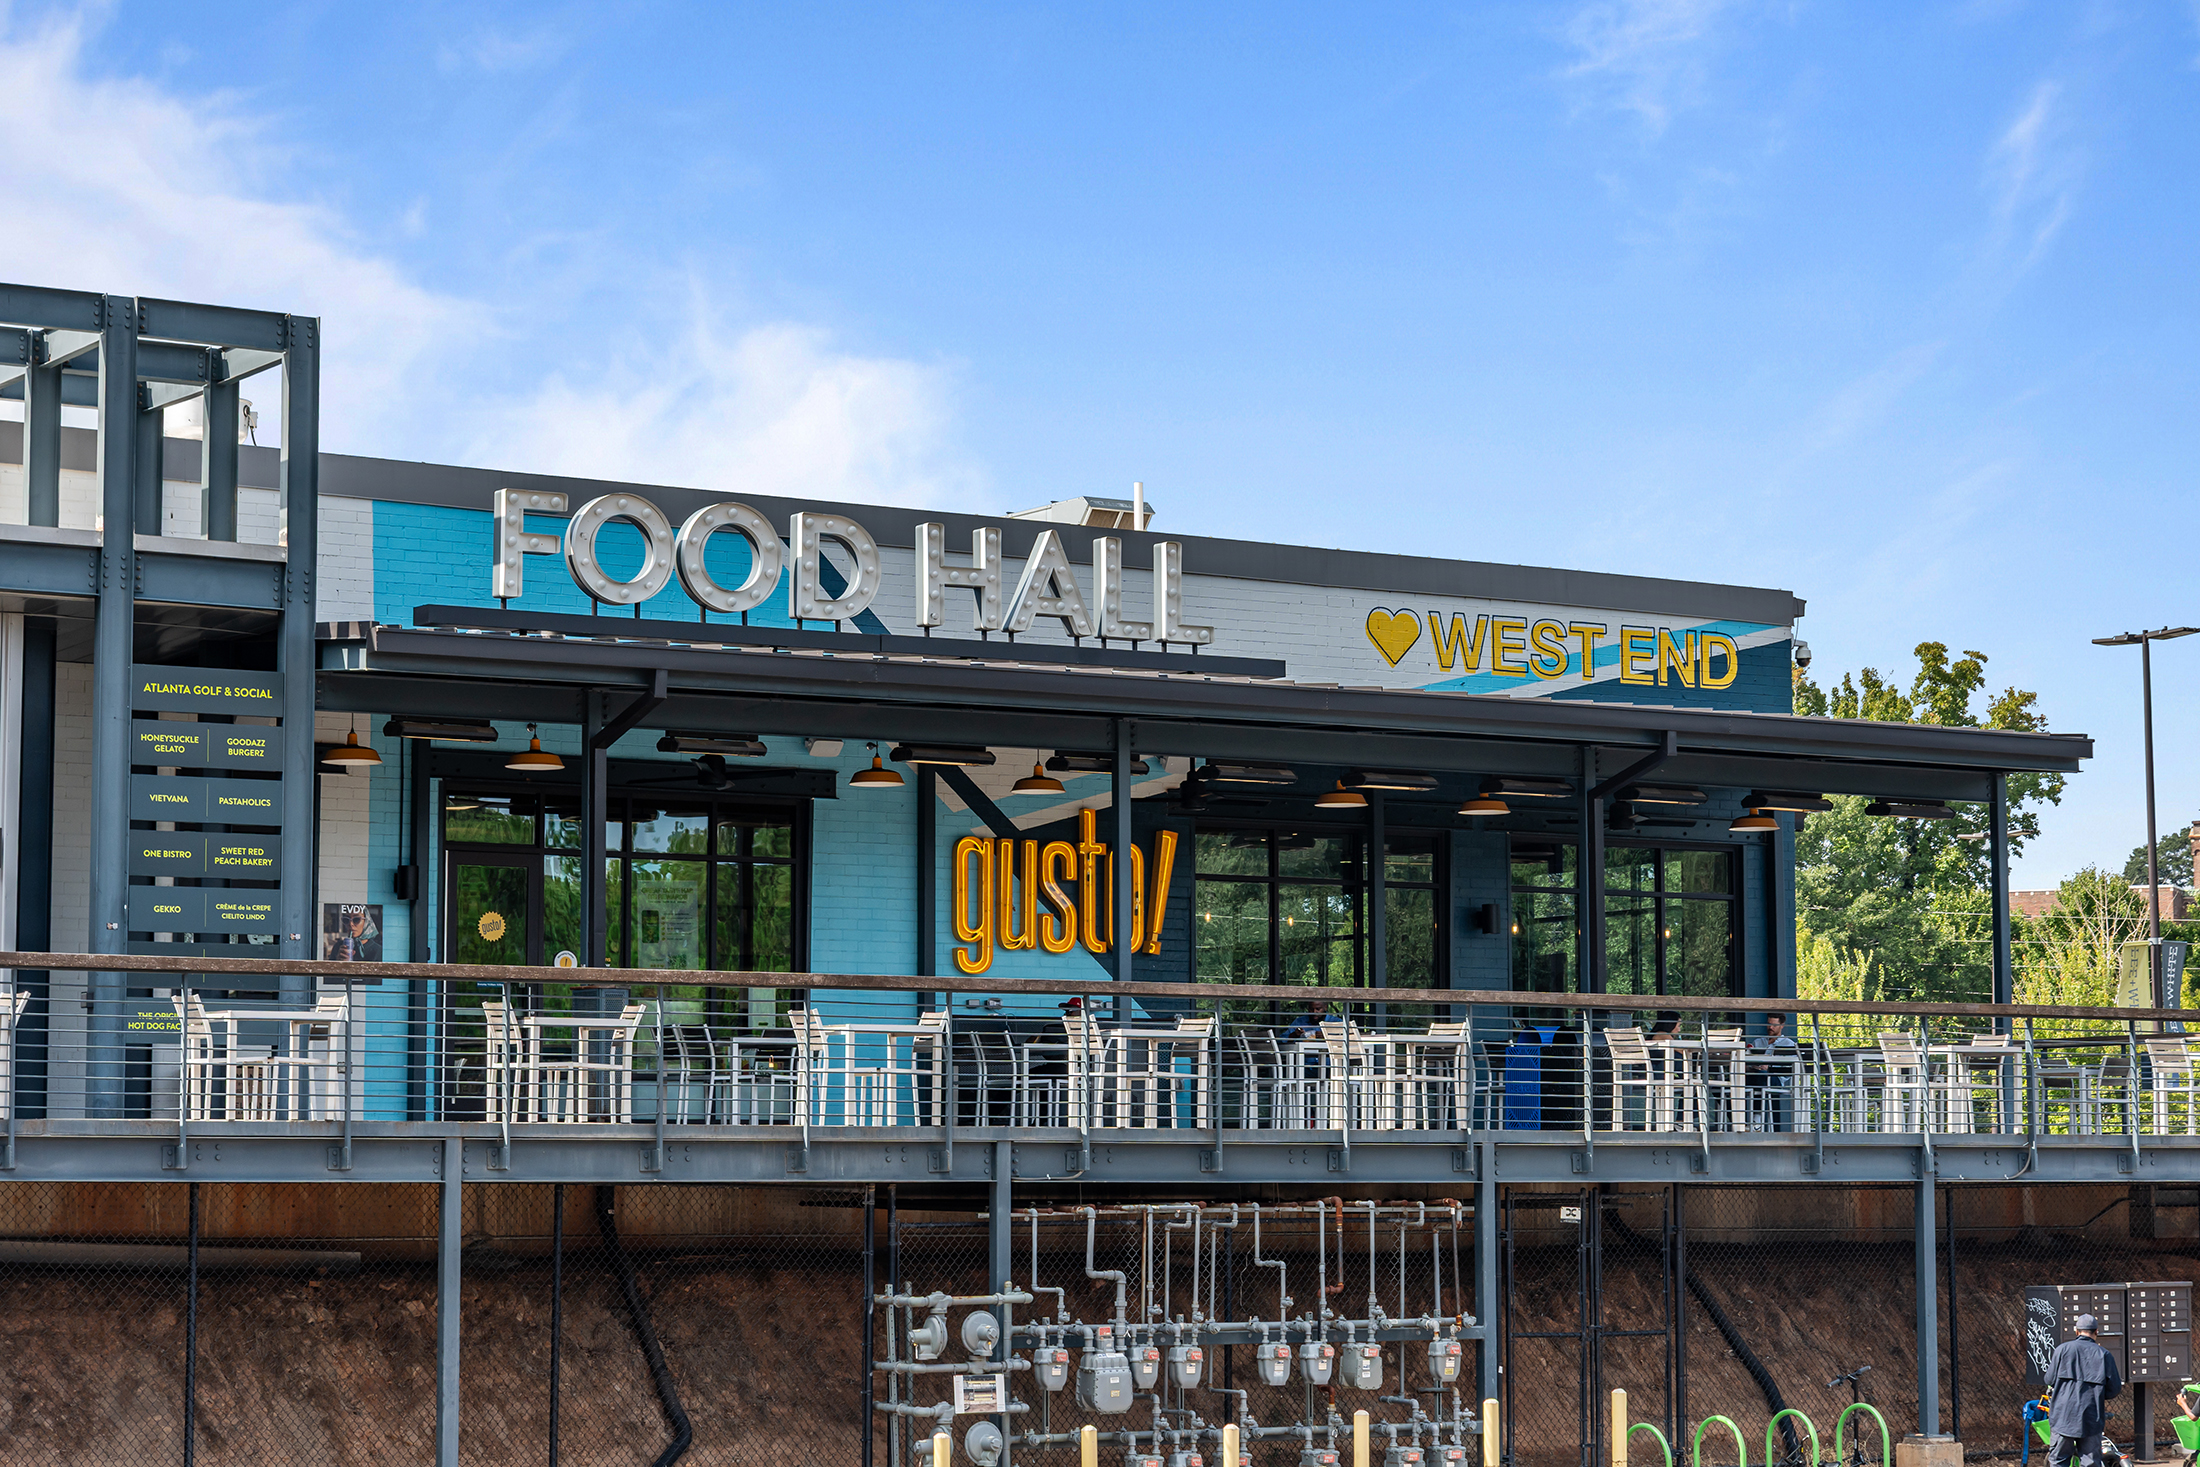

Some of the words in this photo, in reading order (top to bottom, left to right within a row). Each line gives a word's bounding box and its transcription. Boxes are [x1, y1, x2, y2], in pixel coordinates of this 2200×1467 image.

[493, 487, 882, 620] FOOD
[914, 522, 1215, 643] HALL
[1428, 610, 1608, 681] WEST
[1619, 625, 1740, 690] END
[143, 682, 191, 695] ATLANTA
[193, 685, 222, 696] GOLF
[224, 687, 232, 697] &
[234, 688, 273, 699] SOCIAL
[140, 733, 200, 744] HONEYSUCKLE
[226, 737, 266, 747] GOODAZZ
[154, 744, 186, 754] GELATO
[228, 748, 265, 757] BURGERZ
[149, 794, 189, 803] VIETVANA
[218, 797, 272, 807] PASTAHOLICS
[143, 849, 161, 858] ONE
[163, 850, 192, 859] BISTRO
[220, 847, 246, 856] SWEET
[247, 847, 265, 856] RED
[214, 857, 241, 866] PEACH
[242, 857, 273, 866] BAKERY
[951, 808, 1179, 975] gusto!
[153, 905, 182, 913] GEKKO
[252, 904, 271, 912] CREPE
[341, 904, 366, 914] EVDY
[481, 919, 502, 935] gusto!
[2128, 946, 2139, 979] LEE
[2166, 946, 2178, 1000] WHITE
[128, 1021, 145, 1030] HOT
[146, 1022, 165, 1031] DOG
[1509, 1084, 1537, 1092] RECYCLE
